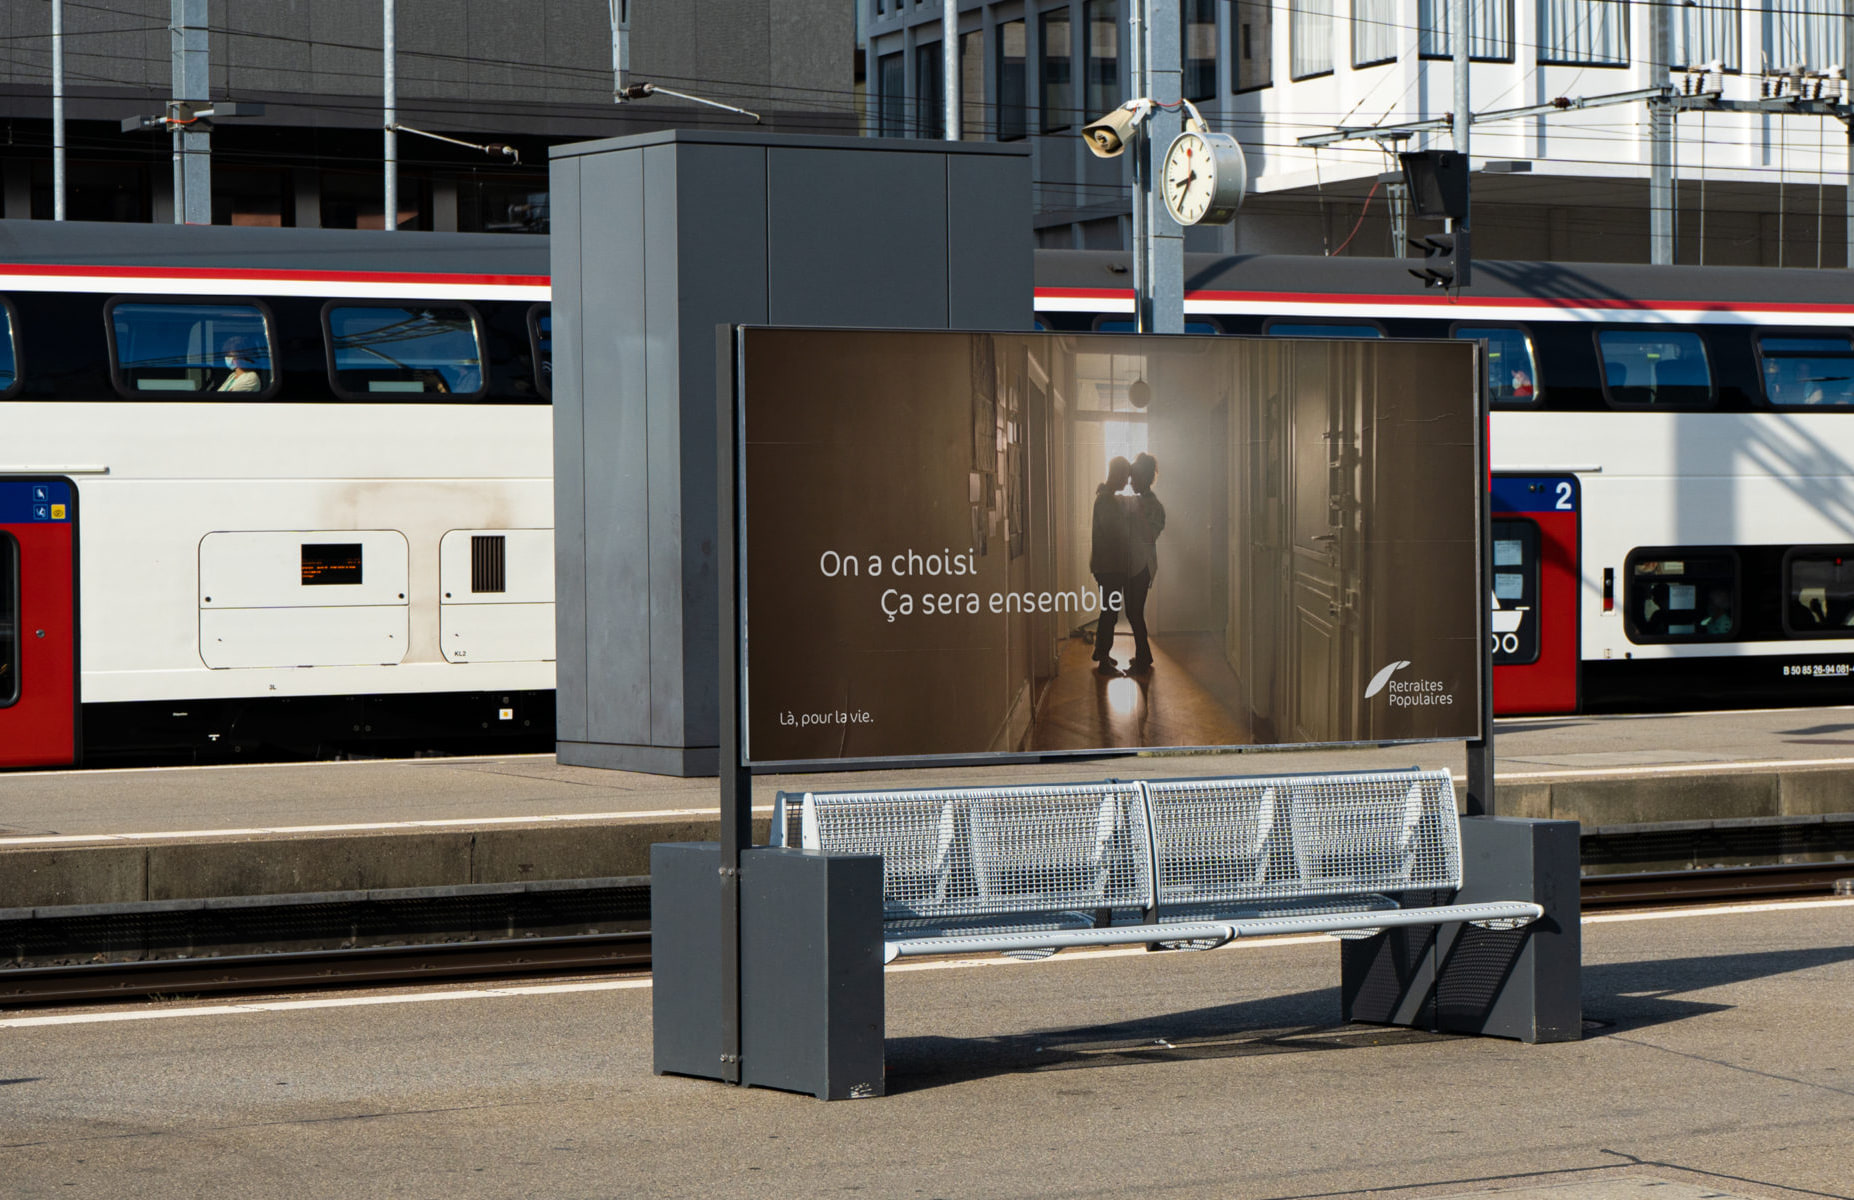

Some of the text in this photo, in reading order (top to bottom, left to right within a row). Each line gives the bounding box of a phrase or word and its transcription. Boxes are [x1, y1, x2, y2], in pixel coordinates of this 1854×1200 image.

[1555, 481, 1572, 510] 2
[820, 547, 977, 577] On a choisi
[881, 585, 1123, 623] Ça sera ensemble
[1783, 664, 1790, 675] B
[1791, 665, 1801, 675] 50
[1802, 664, 1812, 675] 85
[1389, 679, 1443, 693] Retraites
[1389, 692, 1453, 708] Populaires
[780, 709, 874, 727] Là, pour la vie.
